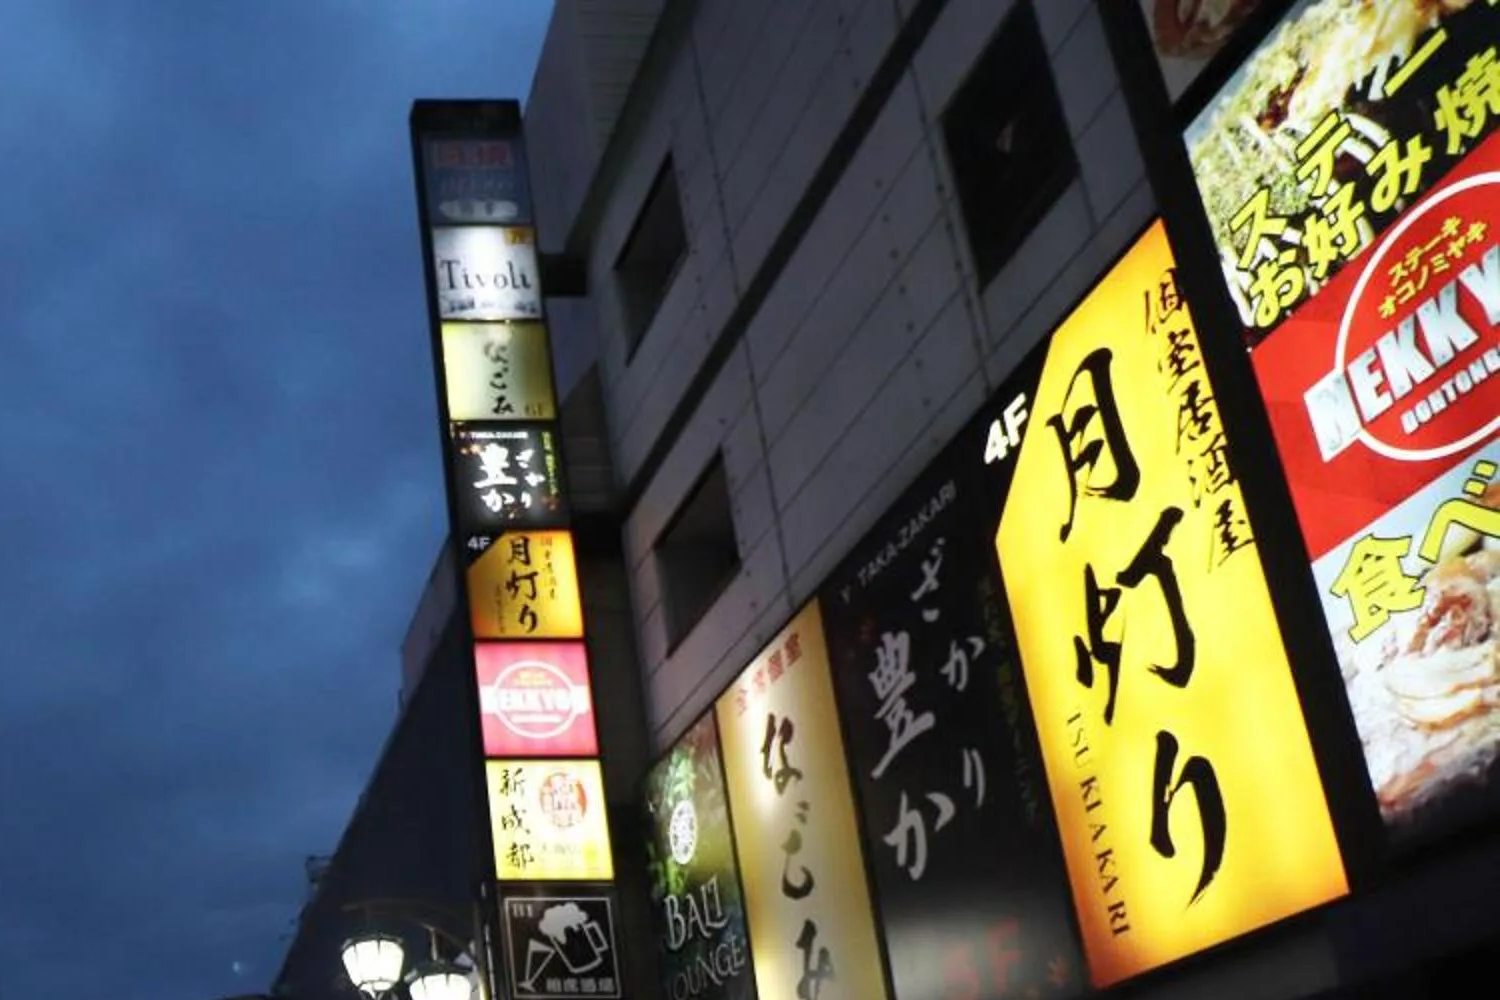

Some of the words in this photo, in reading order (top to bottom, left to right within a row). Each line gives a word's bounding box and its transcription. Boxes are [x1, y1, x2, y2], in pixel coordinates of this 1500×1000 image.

[440, 259, 532, 291] Tivoli
[1378, 222, 1487, 318] オコノミヤキ
[1389, 217, 1461, 284] ステーキ
[983, 393, 1029, 467] 4F
[468, 535, 490, 551] 4F
[507, 535, 537, 633] 月灯り
[1330, 459, 1500, 644] 食べ
[1046, 347, 1228, 911] 月灯り
[500, 768, 535, 869] 新成都
